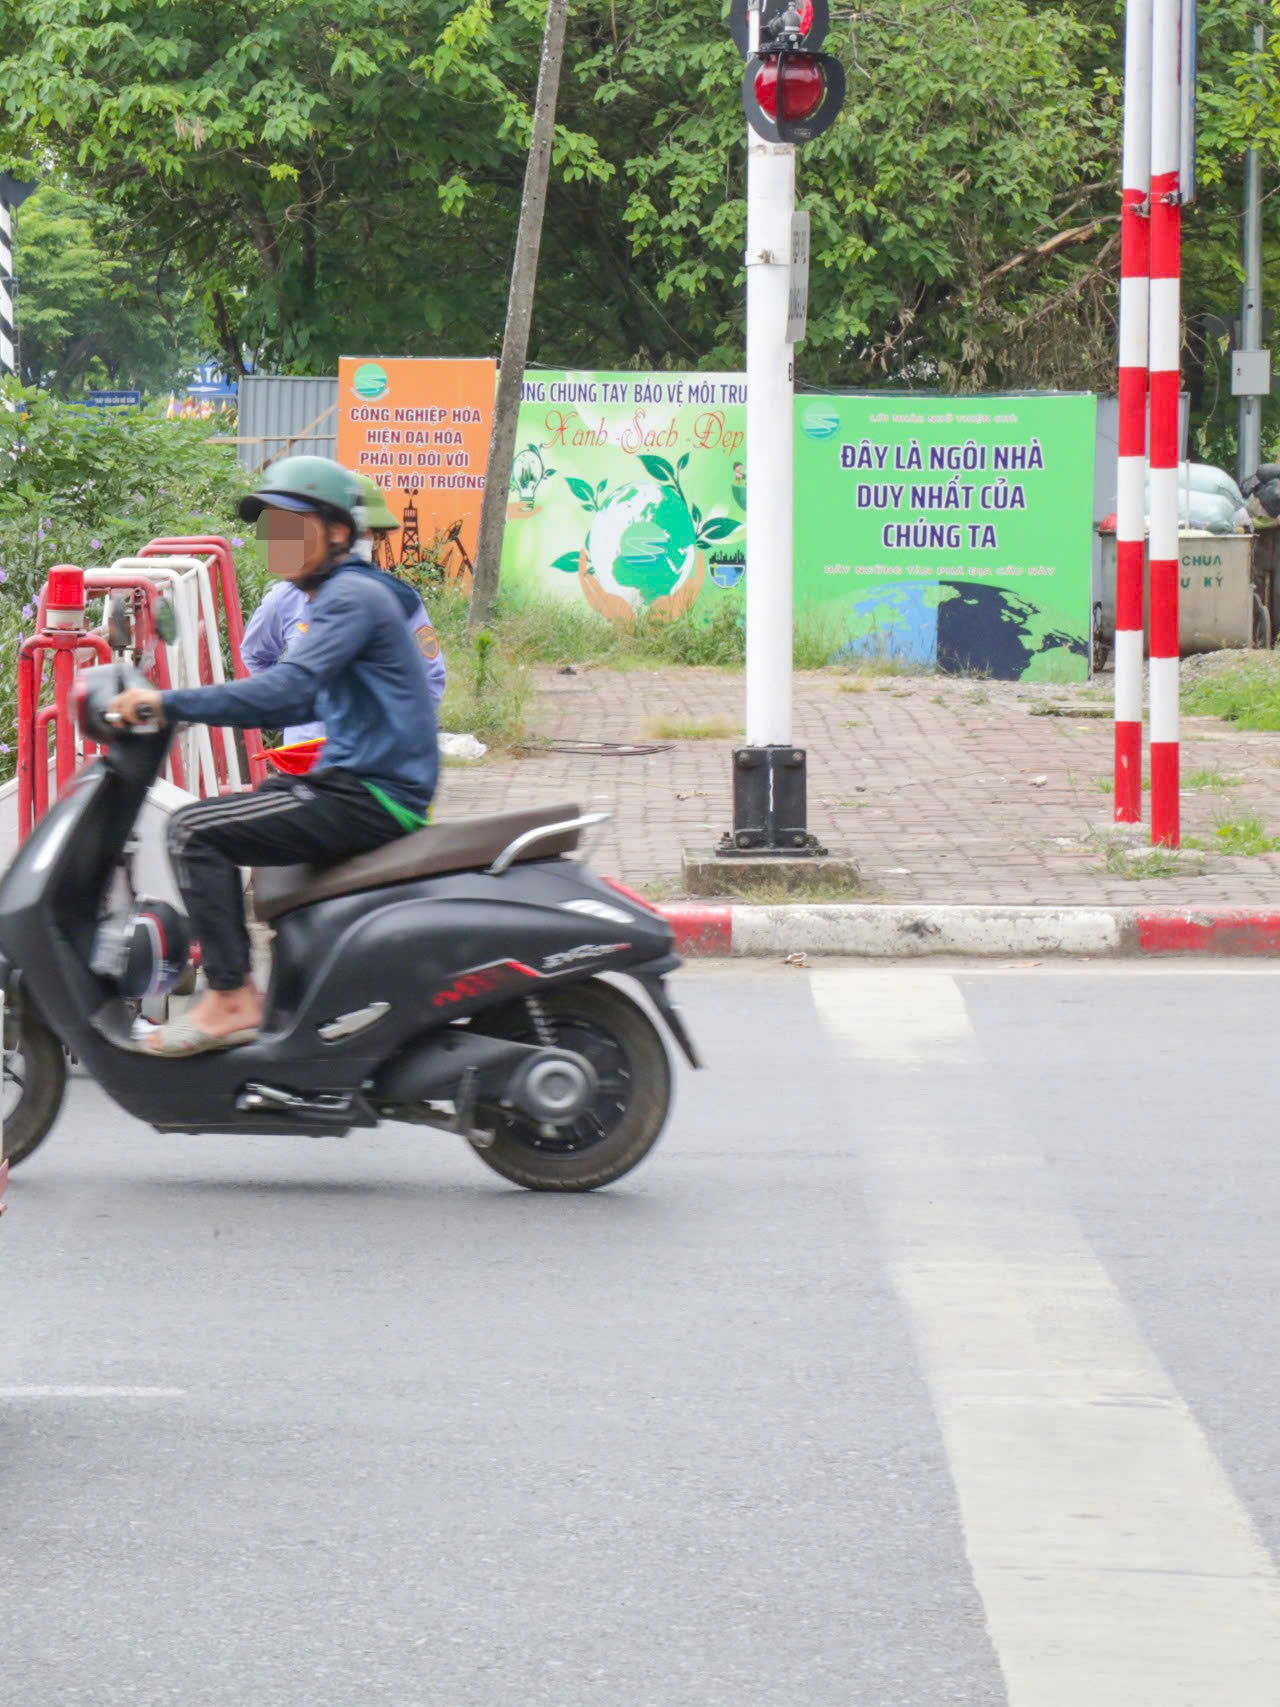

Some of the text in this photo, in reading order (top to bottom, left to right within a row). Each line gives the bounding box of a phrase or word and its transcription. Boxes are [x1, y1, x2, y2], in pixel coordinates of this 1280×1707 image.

[550, 383, 597, 403] CHUNG
[601, 383, 629, 403] TAY
[634, 379, 663, 404] BẢO
[667, 380, 684, 408] VỆ
[688, 380, 716, 404] MÔI
[350, 405, 482, 425] CÔNG NGHIỆP HÓA
[367, 428, 463, 447] HIỆN ĐẠI HÓA
[542, 407, 745, 457] Xanh Sạch Đẹp
[360, 447, 469, 467] PHẢI ĐI ĐÔI VỚI
[840, 438, 1044, 470] ĐÂY LÀ NGÔI NHÀ
[375, 471, 392, 491] VỆ
[397, 471, 425, 489] MÔI
[856, 474, 1026, 509] DUY NHẤT CỦA
[883, 517, 997, 548] CHÚNG TA
